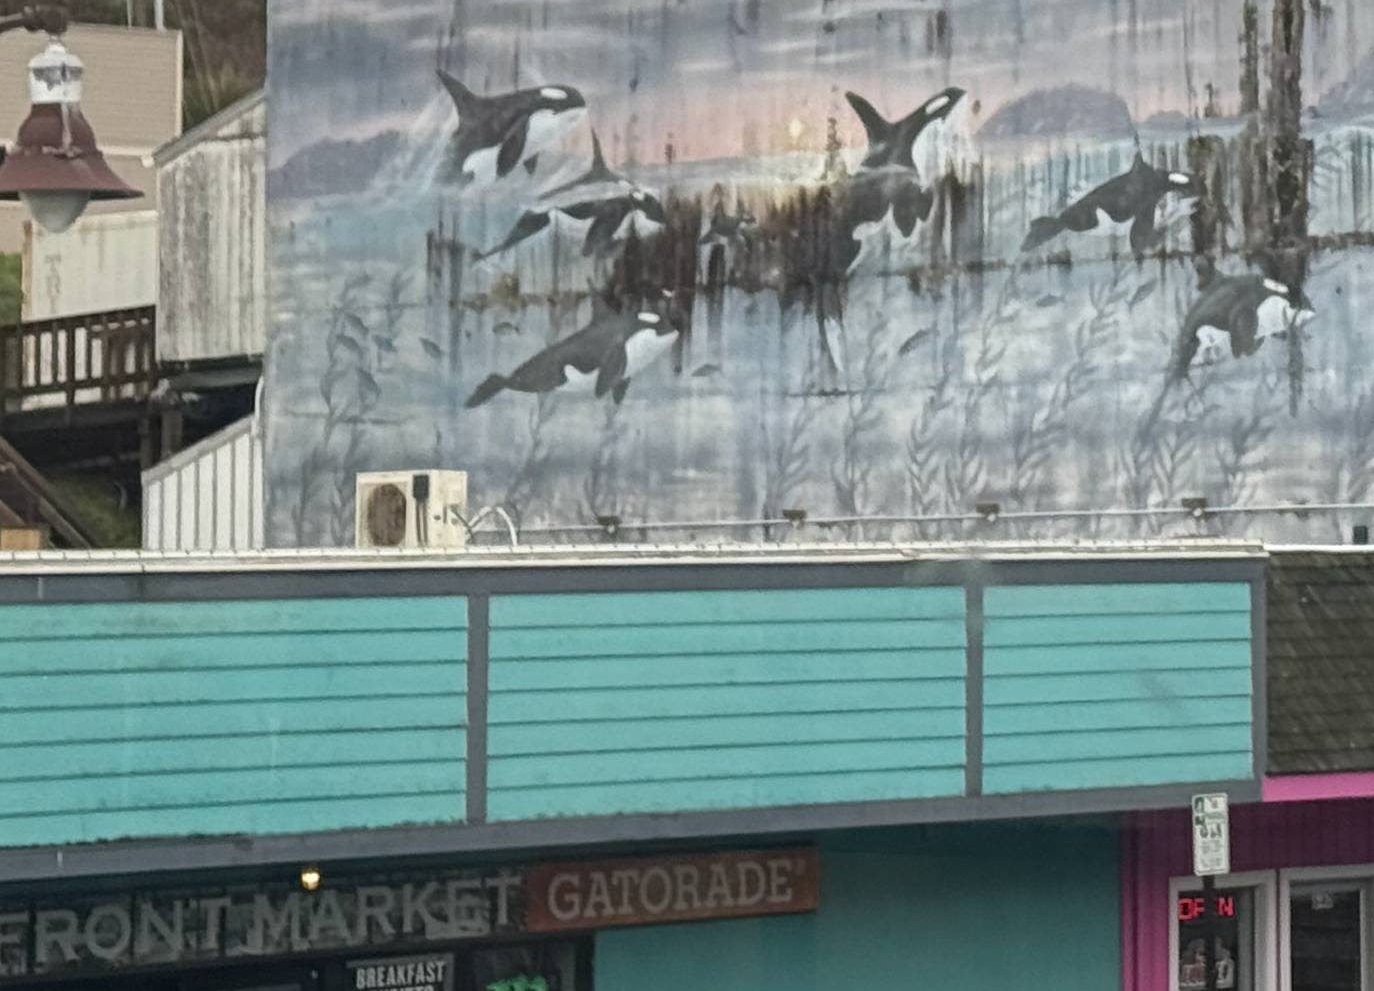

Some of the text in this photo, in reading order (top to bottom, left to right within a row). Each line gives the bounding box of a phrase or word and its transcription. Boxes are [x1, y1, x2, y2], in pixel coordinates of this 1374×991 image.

[250, 874, 522, 955] MARKET
[548, 858, 794, 921] GATORADE
[355, 960, 446, 990] BREAKFAST
